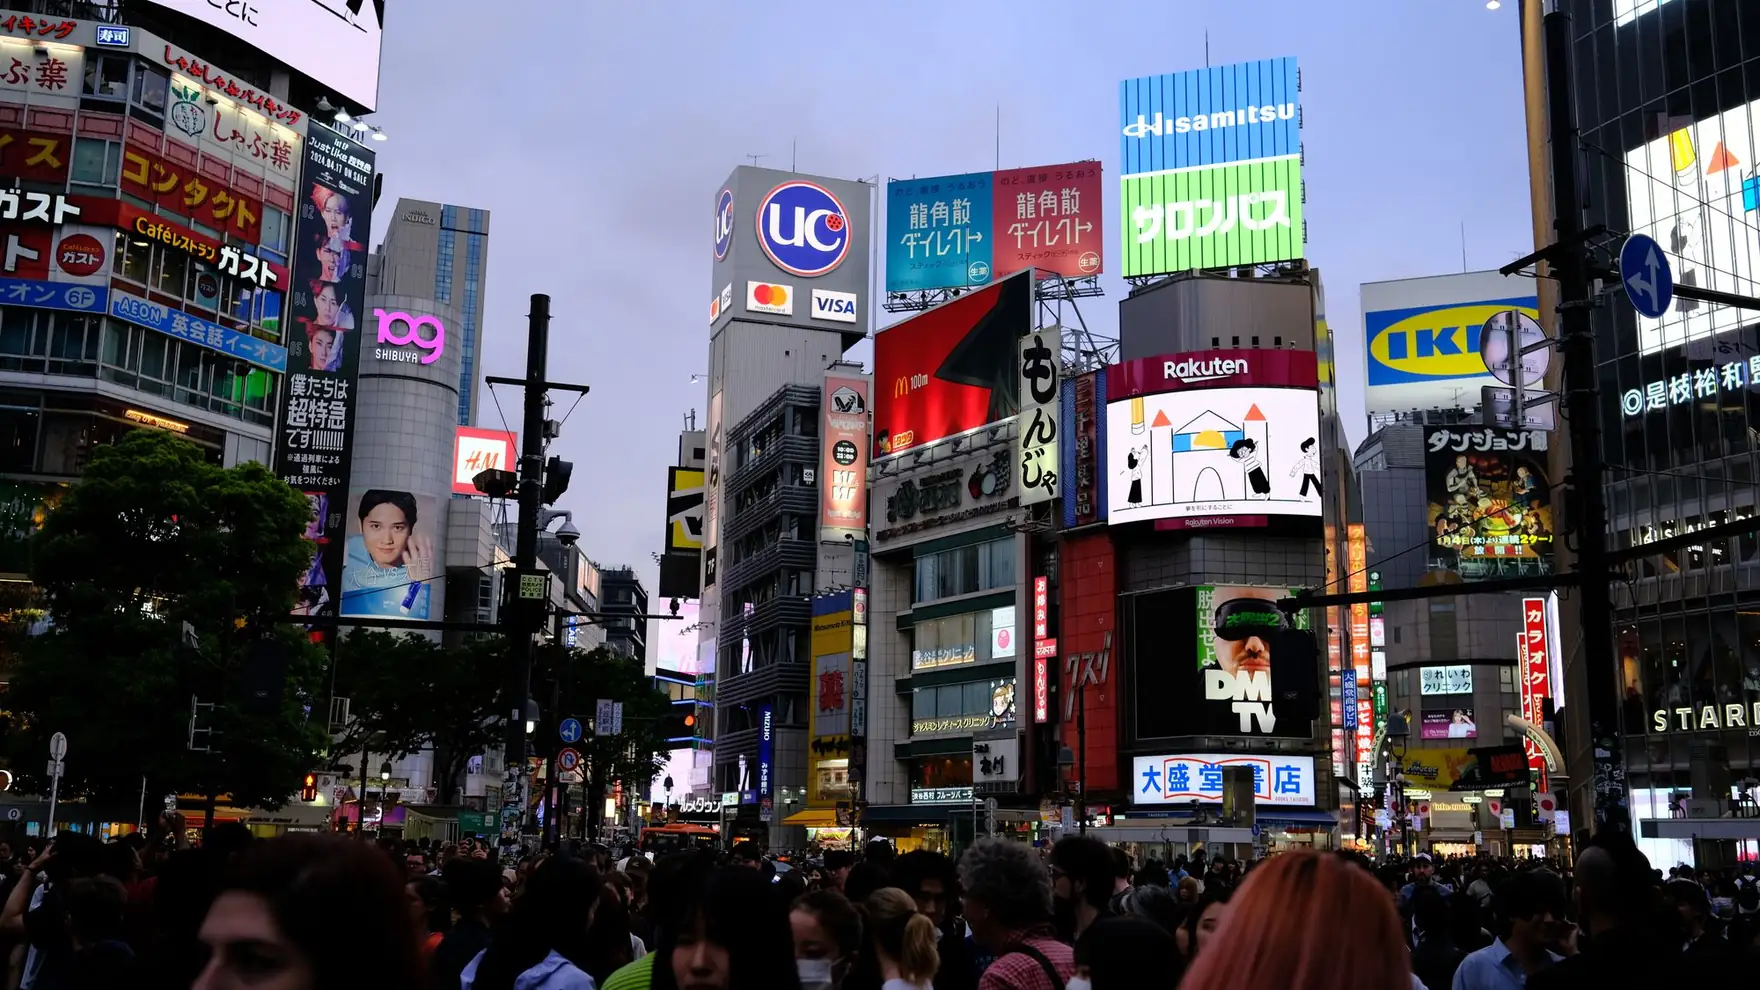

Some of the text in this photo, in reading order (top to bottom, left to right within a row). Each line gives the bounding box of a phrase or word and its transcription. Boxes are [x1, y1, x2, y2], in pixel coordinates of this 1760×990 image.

[0, 15, 77, 39] イキング
[100, 30, 126, 43] 寿司
[1123, 102, 1295, 138] Hisamitsu
[214, 111, 292, 170] しゃぶ葉
[310, 151, 367, 186] 2024.04.17 ON SALE
[123, 150, 257, 230] コンタクト
[1017, 187, 1080, 219] 龍角散
[402, 213, 436, 225] INDIGO
[909, 197, 971, 230] 龍角散
[1132, 190, 1290, 243] サロンパス
[900, 227, 982, 259] ダイレクト
[1007, 218, 1093, 249] ダイレクト
[62, 252, 99, 265] ガスト
[218, 246, 277, 287] ガスト
[0, 284, 93, 305] オン 6F
[754, 305, 786, 313] mastercard
[815, 296, 854, 315] VISA
[119, 297, 163, 325] AEON
[373, 308, 445, 364] 109
[1388, 324, 1482, 360] IK
[375, 348, 418, 363] SHIBUYA
[1164, 357, 1248, 379] Rakuten
[290, 373, 349, 399] 僕たちは
[910, 373, 929, 390] 100m
[287, 397, 347, 429] 超特急
[1022, 335, 1057, 495] もんじゃ
[465, 449, 499, 471] H&M
[284, 475, 340, 486] お気をつけください
[1185, 517, 1235, 528] Rakuten Vision
[1527, 609, 1546, 686] カラオケ
[1064, 630, 1112, 722] クスリ
[1205, 669, 1273, 701] DM
[1423, 681, 1472, 693] クリニック
[1434, 669, 1470, 680] れいわ
[1231, 701, 1277, 734] TV
